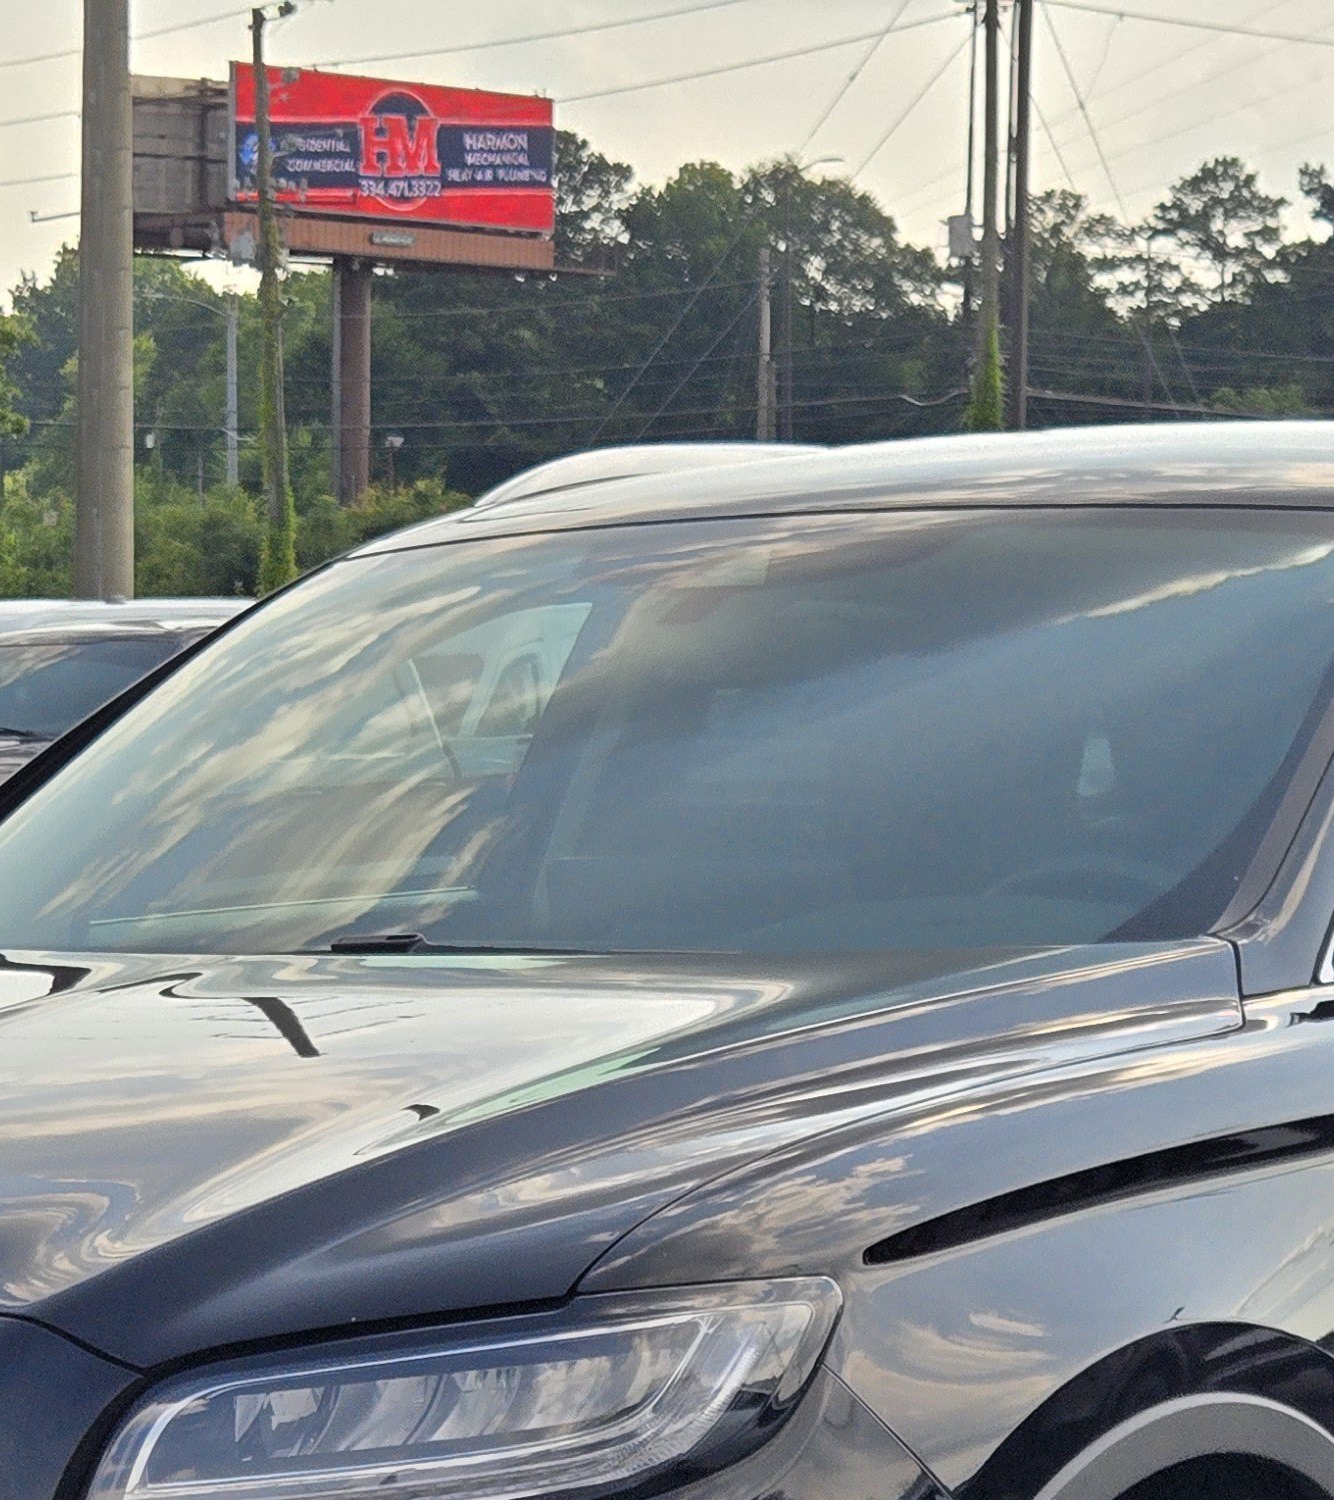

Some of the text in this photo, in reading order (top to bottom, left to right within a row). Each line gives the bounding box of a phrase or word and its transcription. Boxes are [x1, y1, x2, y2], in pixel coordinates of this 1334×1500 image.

[283, 137, 351, 153] SIDENTIAL
[358, 115, 442, 177] HM
[463, 132, 529, 150] HARMON
[287, 158, 356, 172] COMMERCIAL
